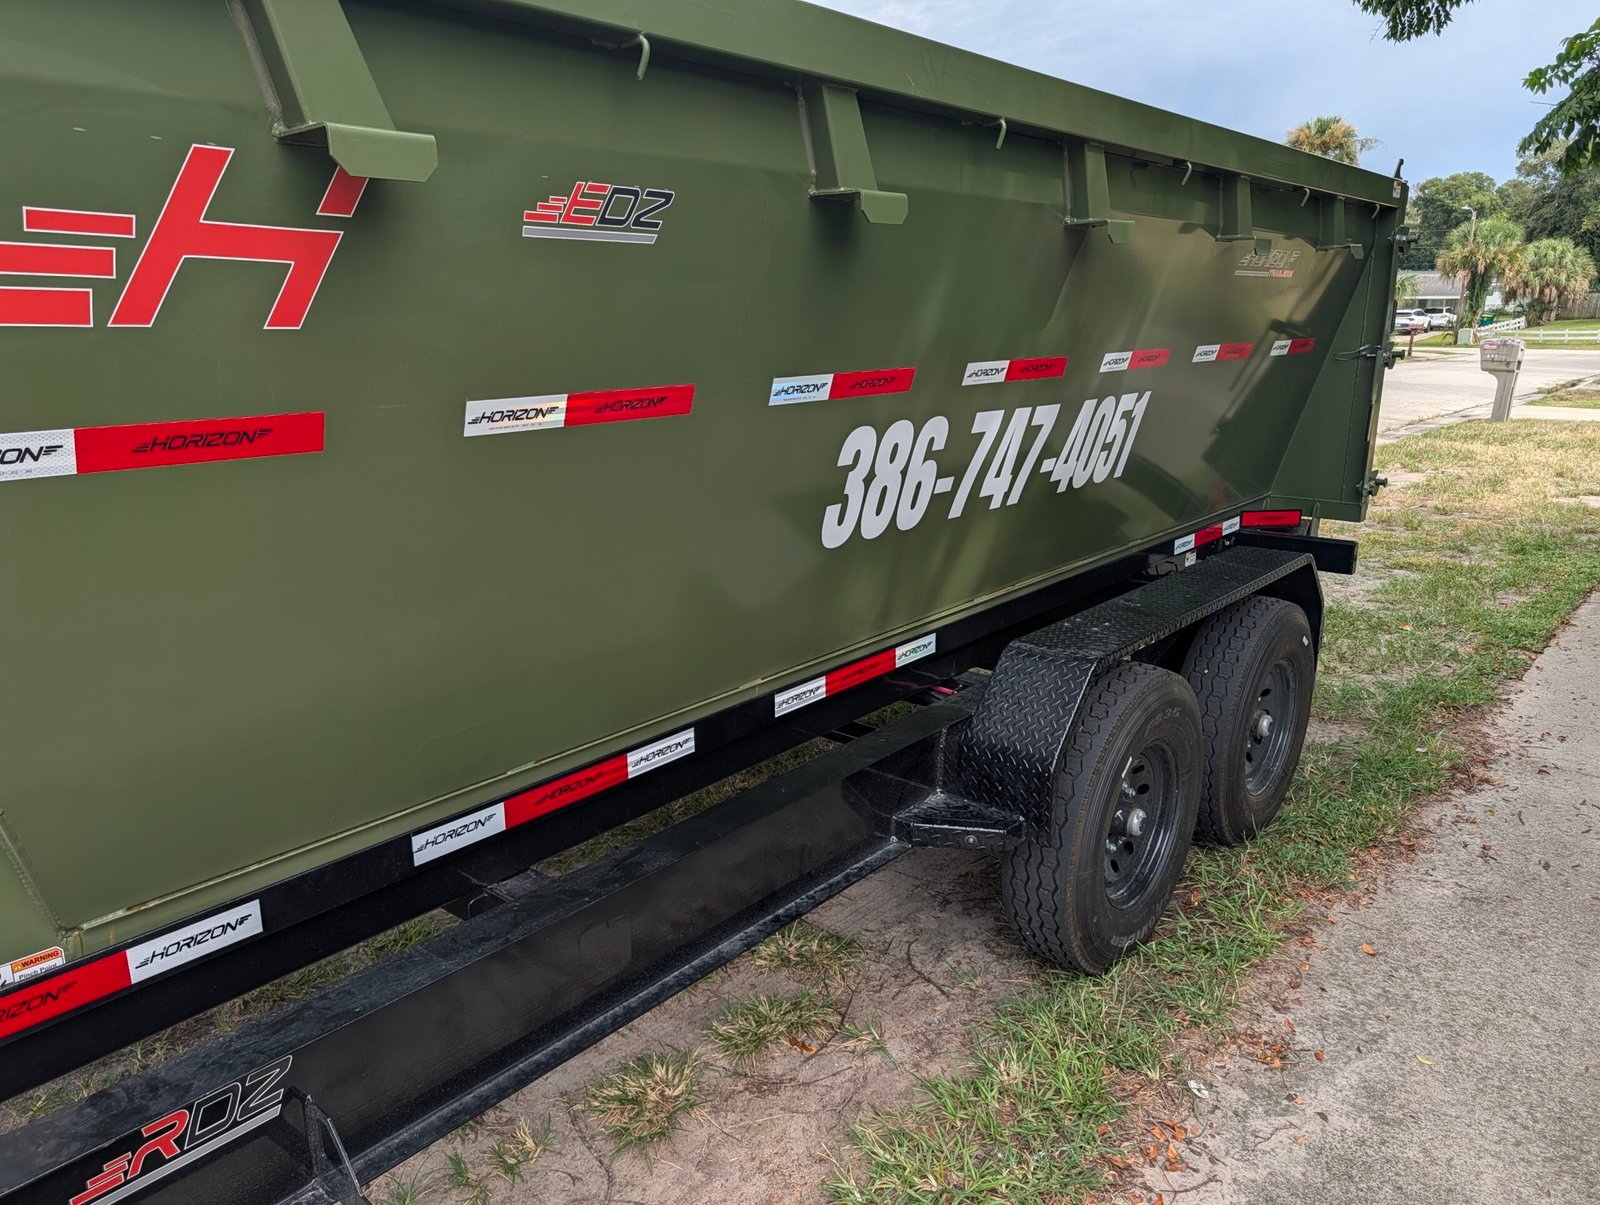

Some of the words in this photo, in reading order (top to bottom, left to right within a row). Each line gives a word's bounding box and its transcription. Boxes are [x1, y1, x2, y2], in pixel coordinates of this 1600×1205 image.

[971, 367, 1004, 378] HORIZON
[779, 383, 823, 396] HORIZON
[854, 377, 892, 389] HORIZON
[602, 396, 661, 413] HORIZON
[479, 406, 549, 425] HORIZON
[149, 429, 259, 453] HORIZON
[821, 390, 1152, 549] 386-747-4051
[901, 643, 930, 660] HORIZON
[781, 687, 816, 710] HORIZON
[638, 739, 684, 767] HORIZON
[543, 774, 595, 802] HORIZON
[425, 817, 489, 851] HORIZON
[149, 919, 240, 964] HORIZON
[20, 950, 60, 968] WARNING
[19, 969, 39, 981] Pinch
[39, 962, 58, 974] Point
